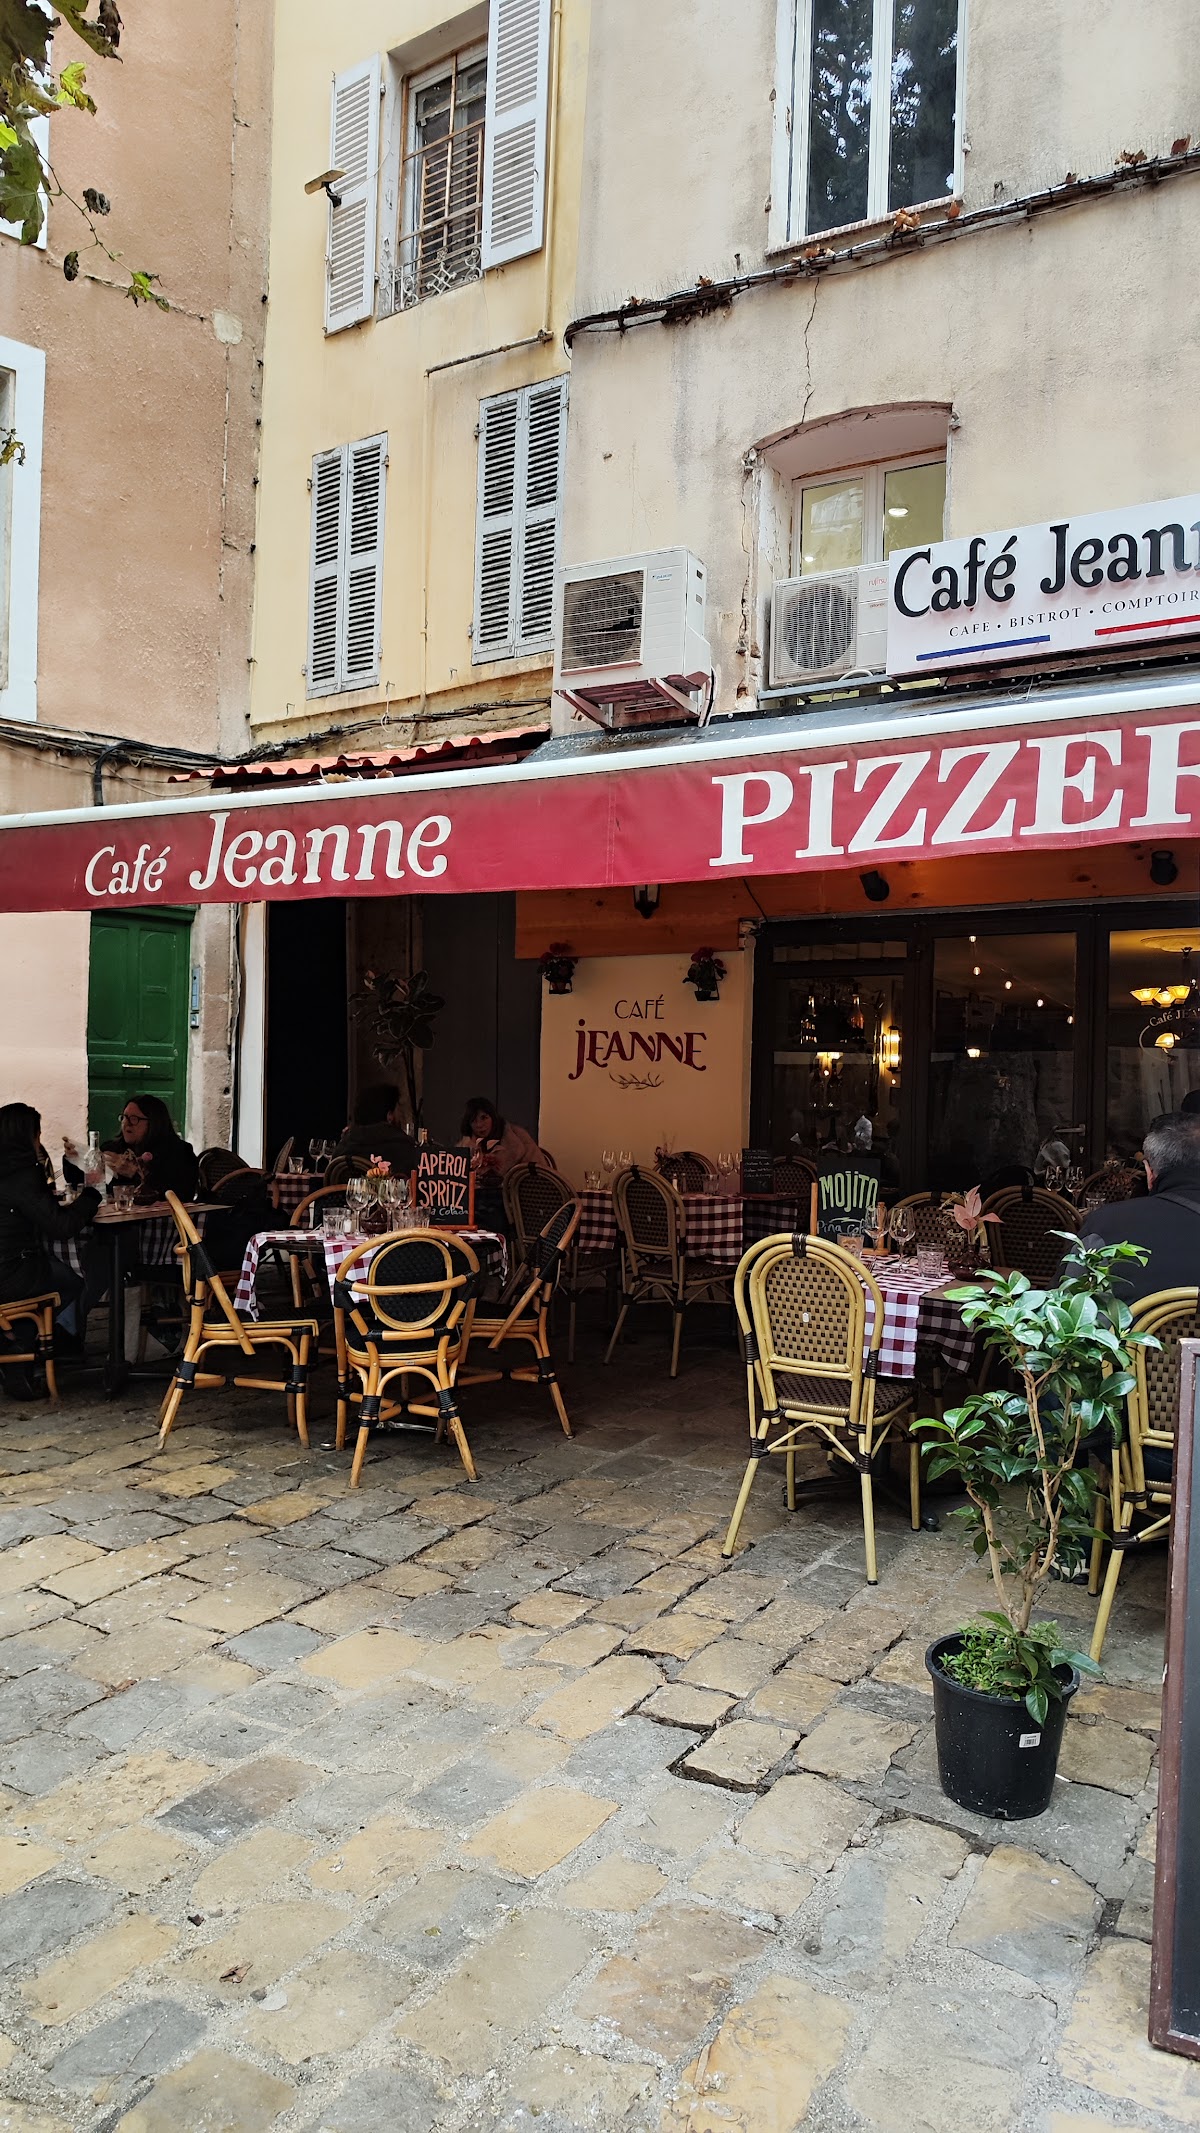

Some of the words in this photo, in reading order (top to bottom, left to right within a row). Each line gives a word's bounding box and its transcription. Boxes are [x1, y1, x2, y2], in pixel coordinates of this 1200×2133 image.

[893, 535, 1018, 618] Café
[1039, 521, 1200, 594] Jean
[949, 621, 990, 637] CAFE
[1010, 607, 1082, 628] BISTROT
[709, 720, 1200, 867] PIZZER
[84, 843, 172, 897] Café
[188, 811, 453, 891] Jeanne
[614, 994, 665, 1020] CAFÉ
[1149, 1009, 1174, 1027] Café
